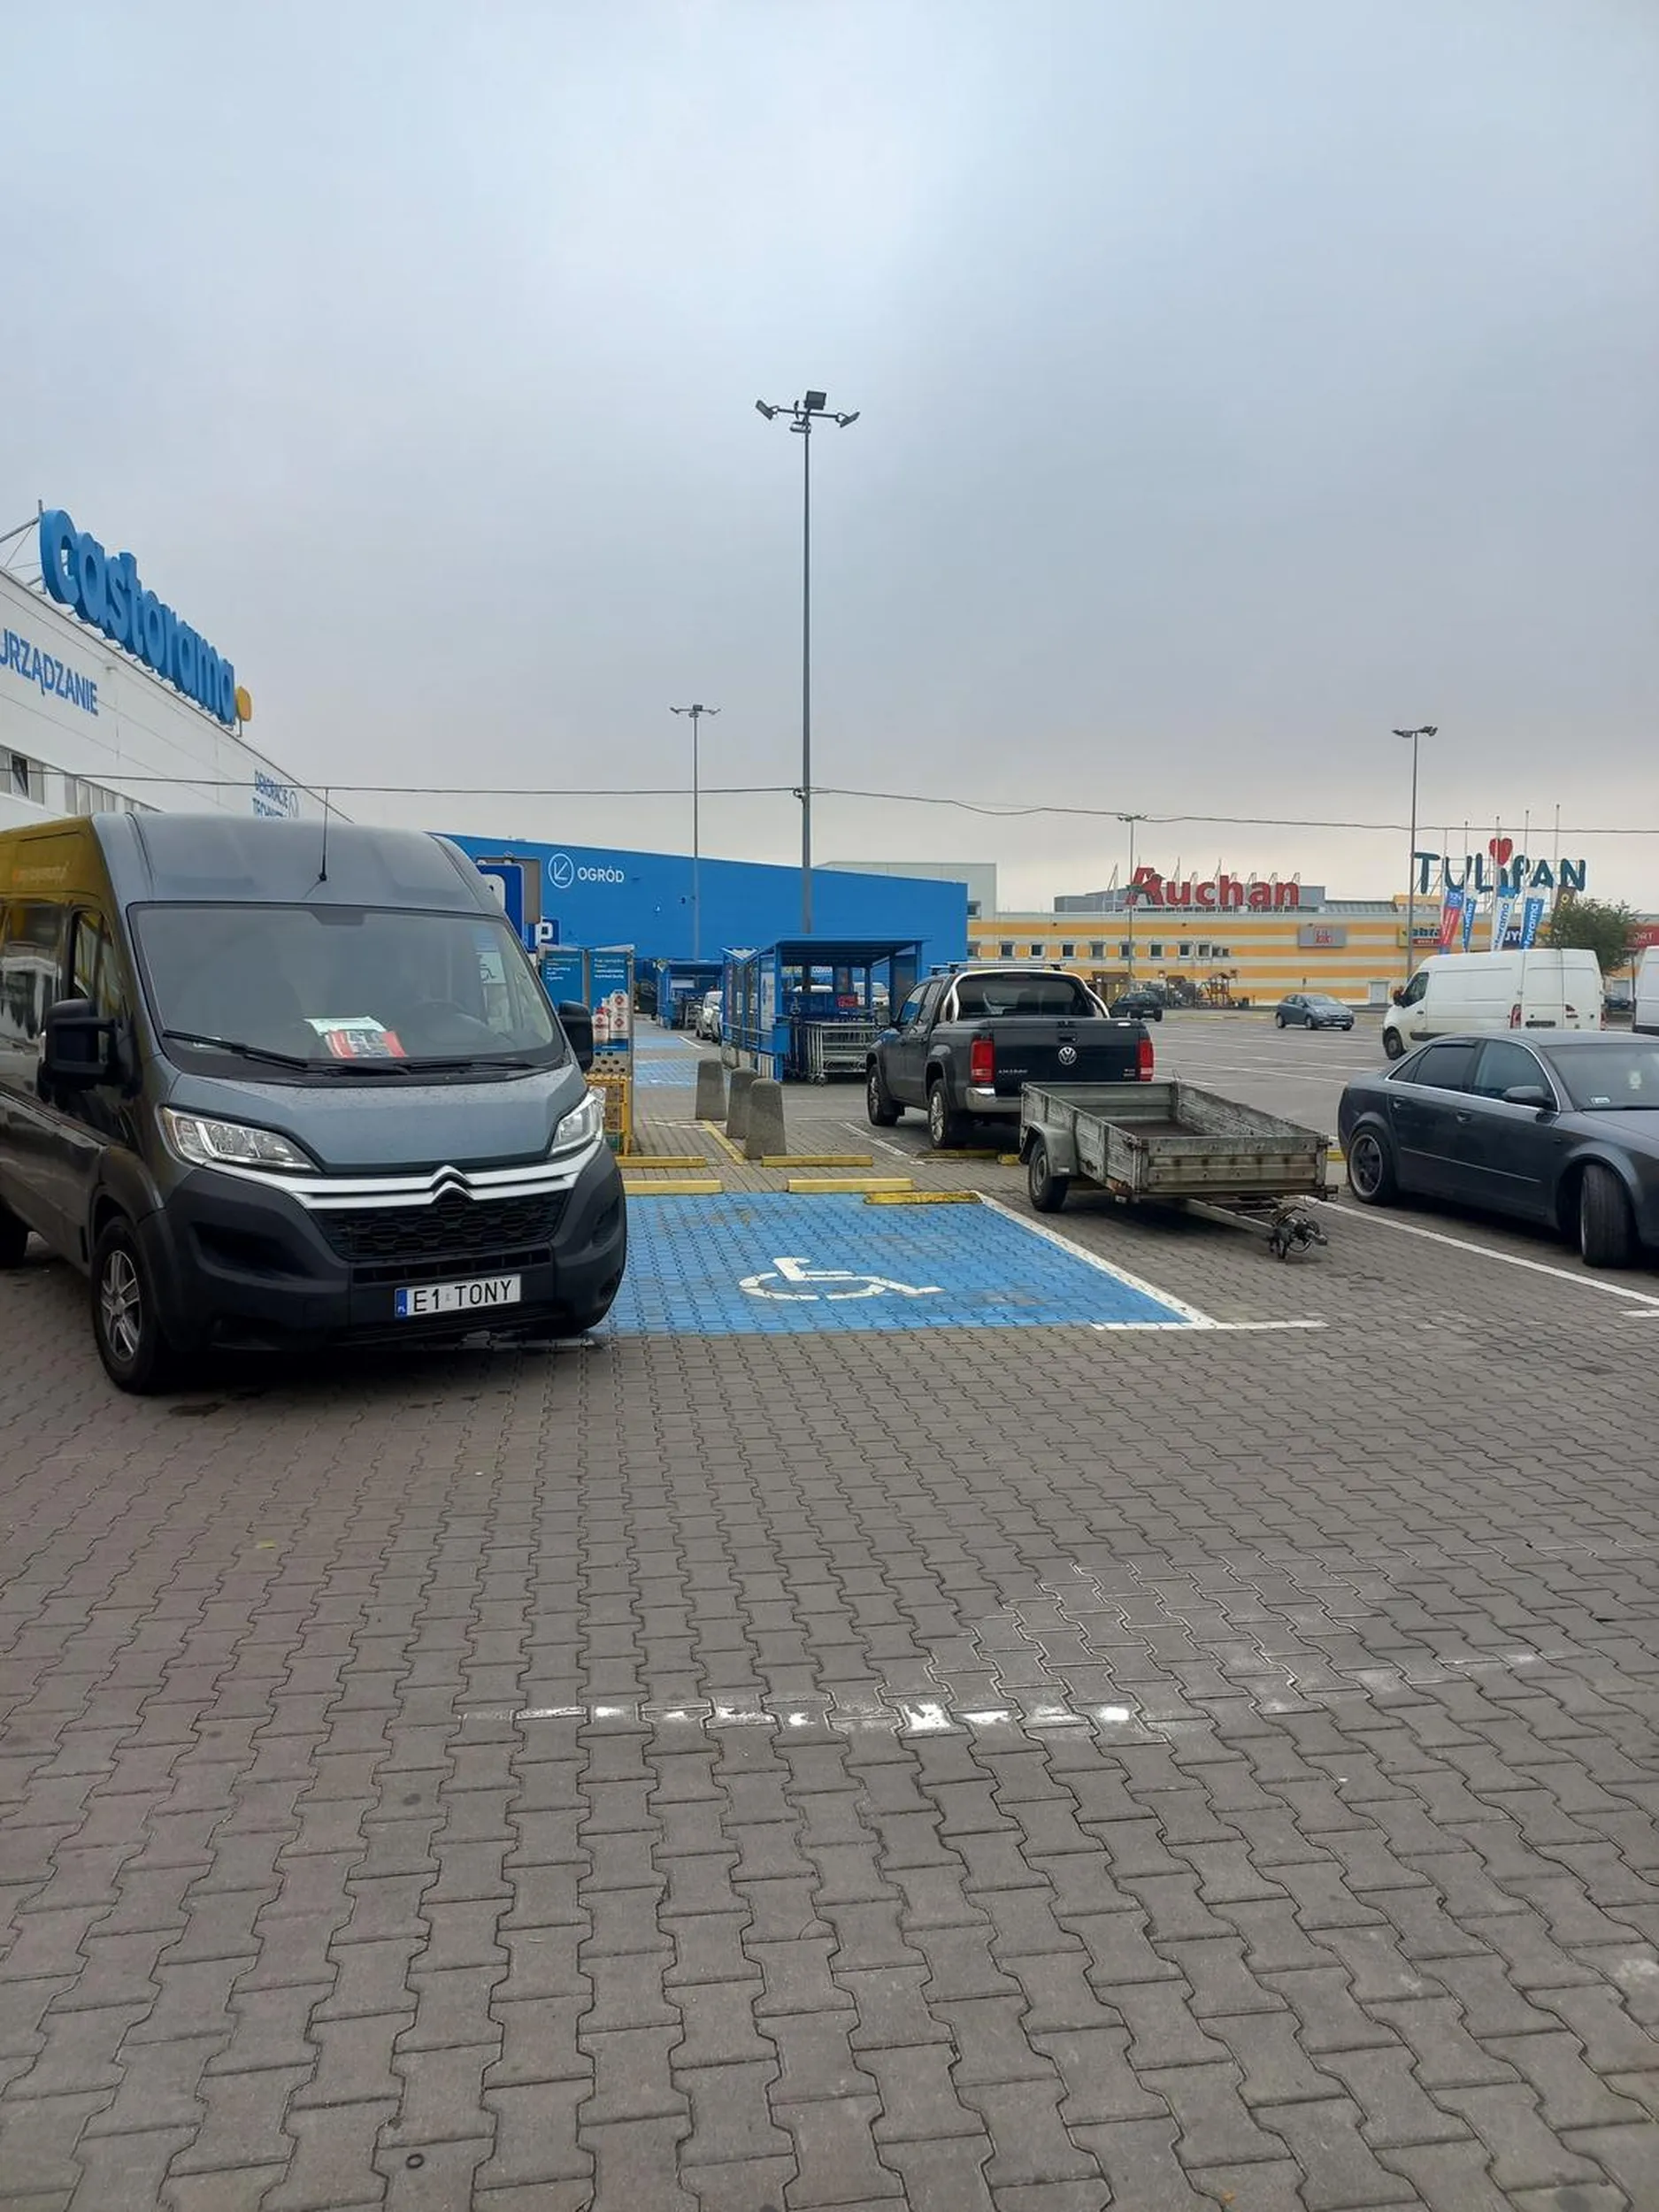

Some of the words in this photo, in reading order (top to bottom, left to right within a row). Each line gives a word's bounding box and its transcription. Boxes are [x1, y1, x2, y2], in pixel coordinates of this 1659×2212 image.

[577, 864, 625, 883] OGRÓD
[1125, 867, 1300, 906] Auchan
[534, 921, 554, 946] P
[413, 1288, 440, 1312] E1
[454, 1279, 512, 1307] TONY
